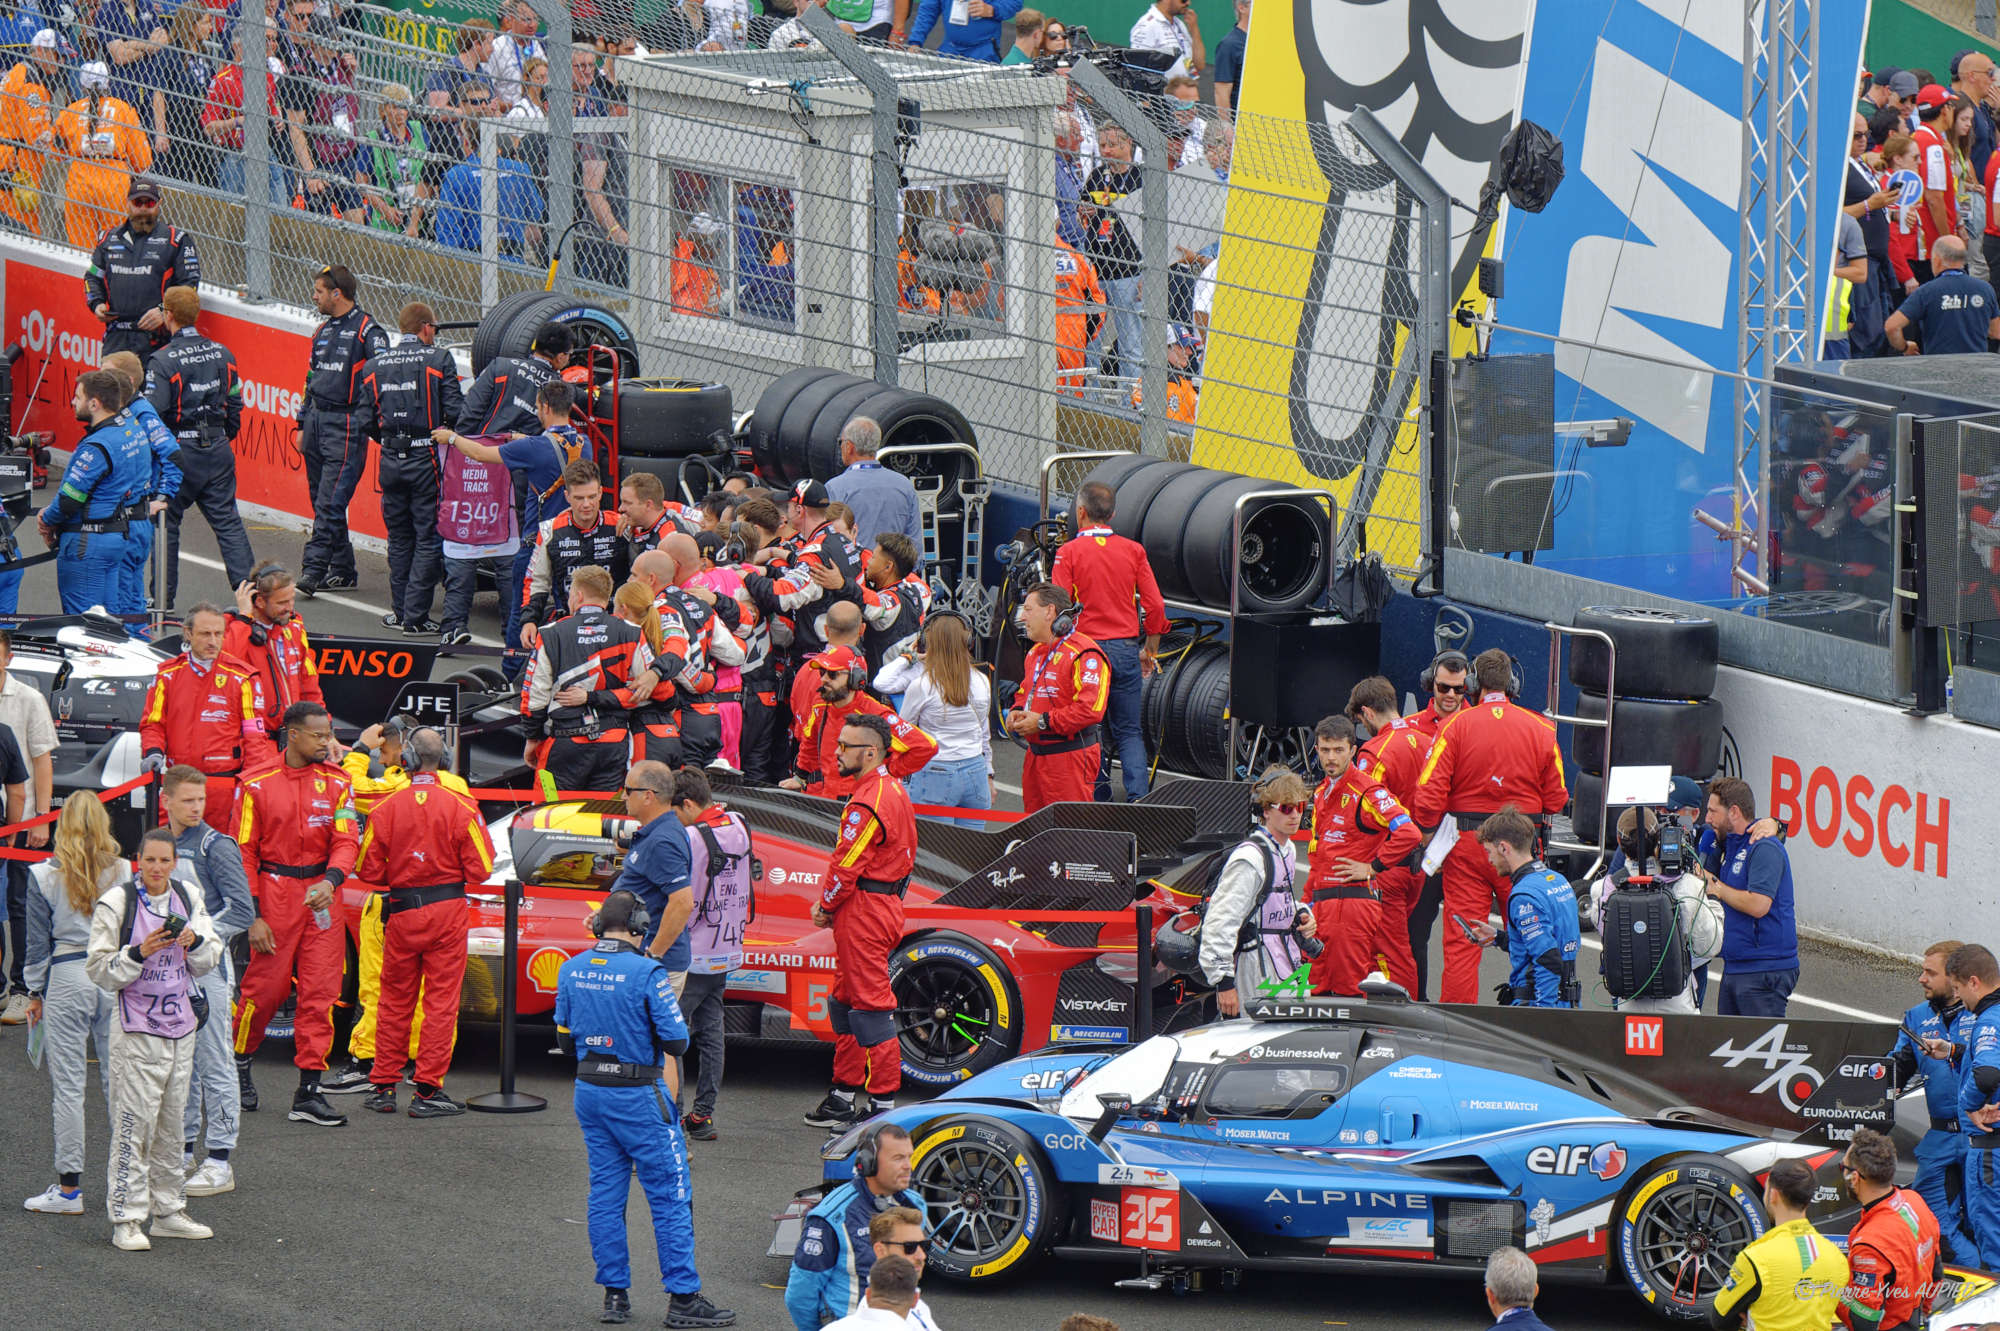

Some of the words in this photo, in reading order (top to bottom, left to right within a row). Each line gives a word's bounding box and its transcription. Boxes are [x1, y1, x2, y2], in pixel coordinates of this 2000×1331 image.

[384, 14, 458, 62] ROLE
[168, 342, 223, 359] CADILLAC
[180, 351, 223, 366] RACING
[377, 356, 425, 367] RACING
[462, 468, 488, 481] MEDIA
[463, 481, 489, 493] TRACK
[450, 500, 499, 524] 1349
[577, 634, 608, 645] DENSO
[400, 695, 451, 712] JFE
[1769, 754, 1951, 880] BOSCH
[787, 871, 822, 884] AT&T
[720, 883, 738, 896] ENG
[808, 955, 838, 969] MIL
[926, 945, 980, 964] MICHELIN
[570, 970, 626, 982] ALPINE
[1060, 998, 1127, 1012] VISTAJET
[1255, 1005, 1350, 1019] ALPINE
[585, 1035, 603, 1046] elf
[1072, 1030, 1123, 1040] MICHELIN
[1627, 1022, 1662, 1048] HY
[1265, 1046, 1343, 1060] businessolver
[1838, 1064, 1869, 1078] elf
[1020, 1069, 1064, 1090] elf
[1109, 1101, 1123, 1110] elf
[1803, 1107, 1886, 1121] EURODATACAR
[120, 1110, 135, 1141] HOST
[1044, 1133, 1088, 1151] GCR
[1525, 1144, 1590, 1177] elf
[112, 1141, 132, 1218] BROADCASTER
[1665, 1174, 1675, 1183] M
[1025, 1174, 1040, 1235] MICHELIN
[1263, 1187, 1428, 1209] ALPINE
[1092, 1201, 1117, 1217] HYPER
[1125, 1193, 1173, 1243] 35
[1364, 1218, 1412, 1232] WEC
[1092, 1215, 1117, 1239] CAR
[1623, 1226, 1644, 1285] MICHELIN
